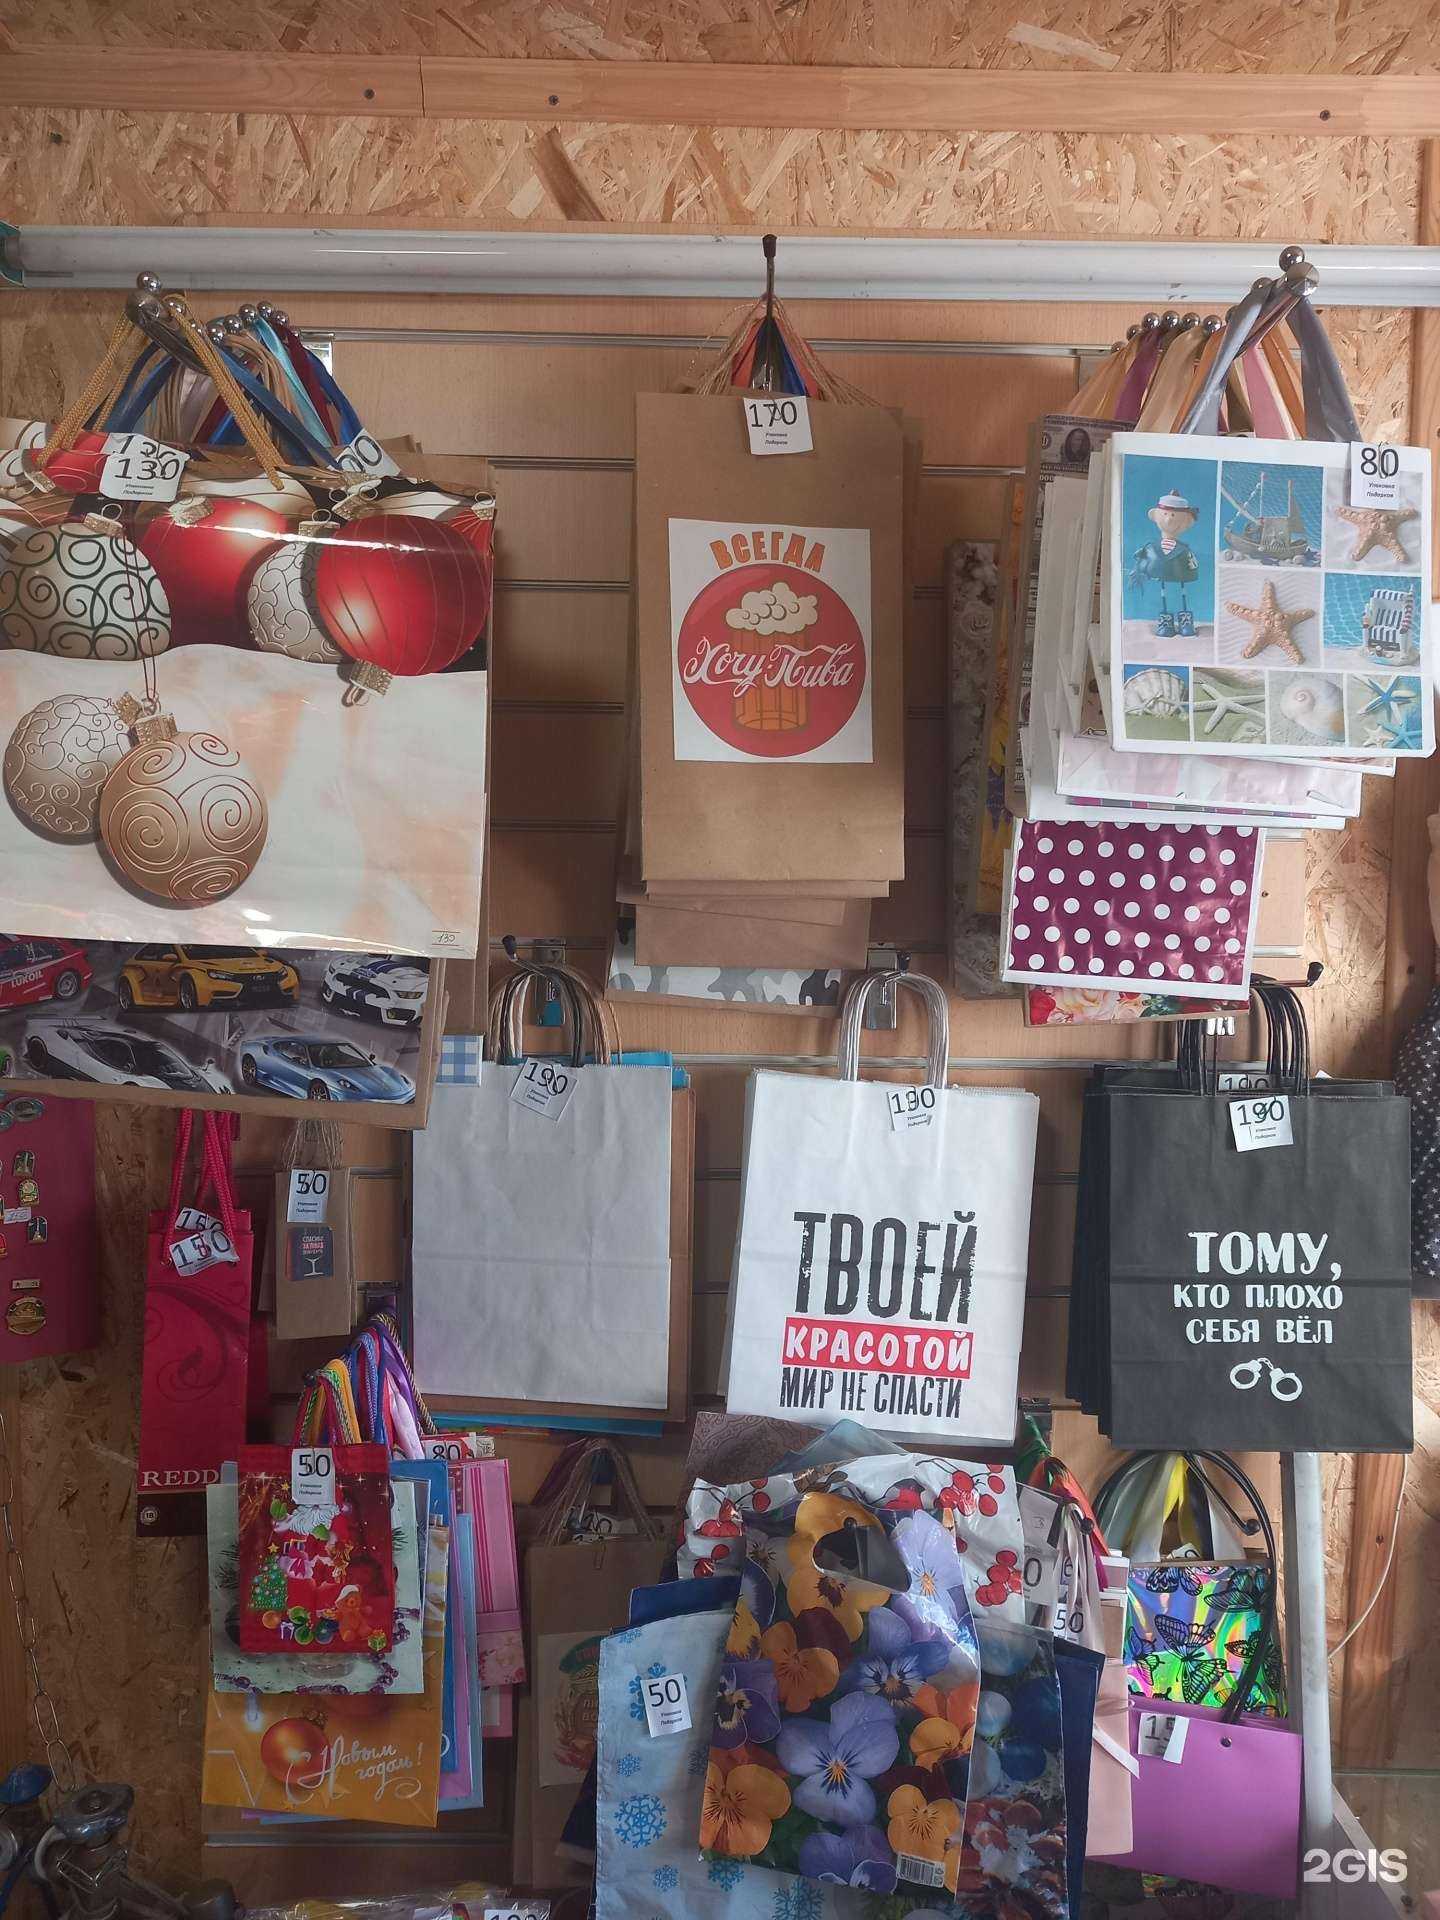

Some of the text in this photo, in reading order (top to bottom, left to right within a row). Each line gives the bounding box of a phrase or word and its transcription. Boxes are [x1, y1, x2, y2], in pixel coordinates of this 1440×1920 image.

[749, 401, 797, 427] 170
[114, 458, 180, 480] 130
[1361, 447, 1399, 477] 80
[709, 531, 826, 573] ВСЕГДА
[524, 1062, 568, 1095] 190
[1237, 1100, 1285, 1126] 190
[794, 1210, 978, 1324] ТВОЕЙ
[1187, 1231, 1342, 1282] ТОМУ,
[1173, 1284, 1343, 1310] КТО ПЛОХО
[1186, 1315, 1333, 1344] СЕБЯ ВЁЛ
[785, 1325, 971, 1372] КРАСОТОЙ
[779, 1367, 963, 1419] МИР НЕ СПАСТИ
[298, 1454, 331, 1477] 50
[1053, 1609, 1085, 1634] 50
[648, 1678, 682, 1708] 50
